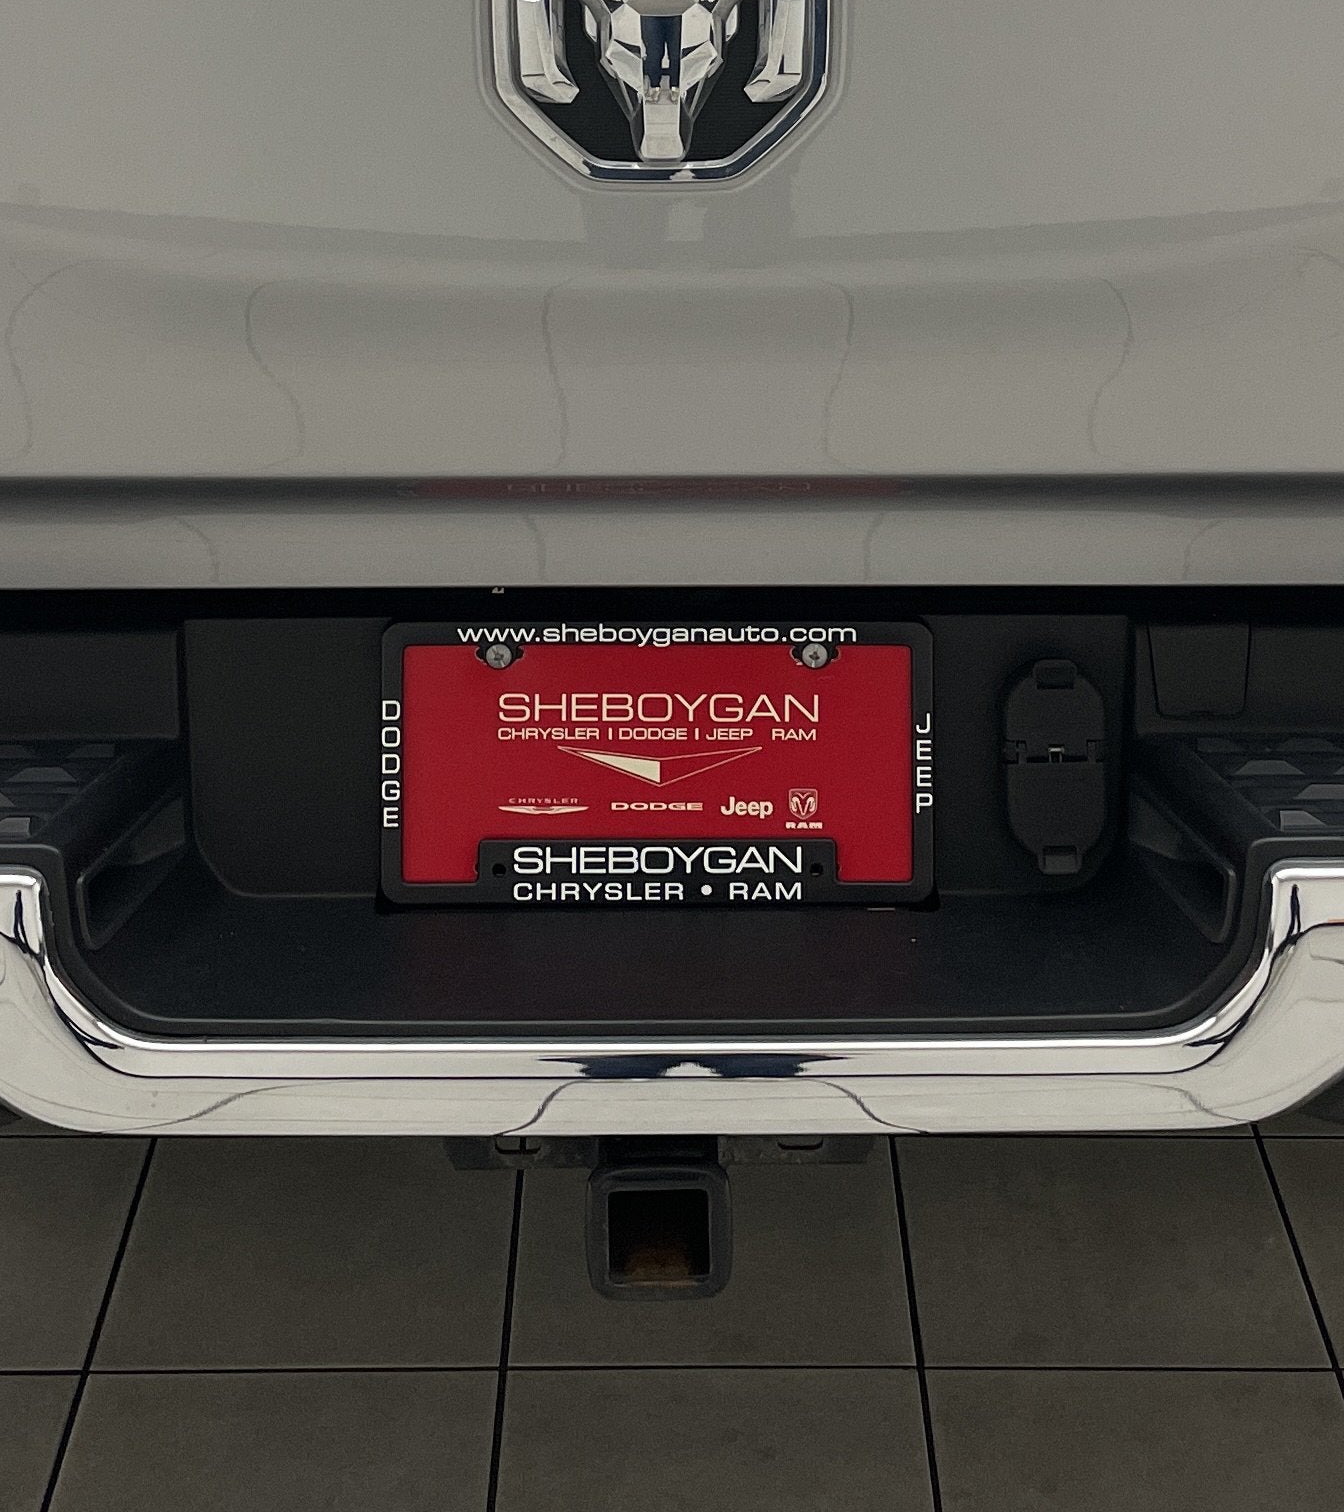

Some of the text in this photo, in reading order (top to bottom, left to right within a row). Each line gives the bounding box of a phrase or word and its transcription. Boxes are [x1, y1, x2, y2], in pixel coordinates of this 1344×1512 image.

[456, 623, 857, 647] www.sheboyganauto.com
[498, 693, 819, 723] SHEBOYGAN
[497, 727, 600, 741] CHRYSLER
[618, 727, 688, 741] DODGE
[705, 727, 754, 741] JEEP
[771, 728, 817, 741] RAM
[381, 699, 401, 828] DODGE
[915, 712, 934, 814] JEEP
[610, 802, 704, 811] DODGE
[720, 796, 774, 819] Jeep
[785, 821, 823, 829] RAM
[513, 846, 802, 874] SHEBOYGAN
[513, 882, 802, 901] CHRYSLER RAM
